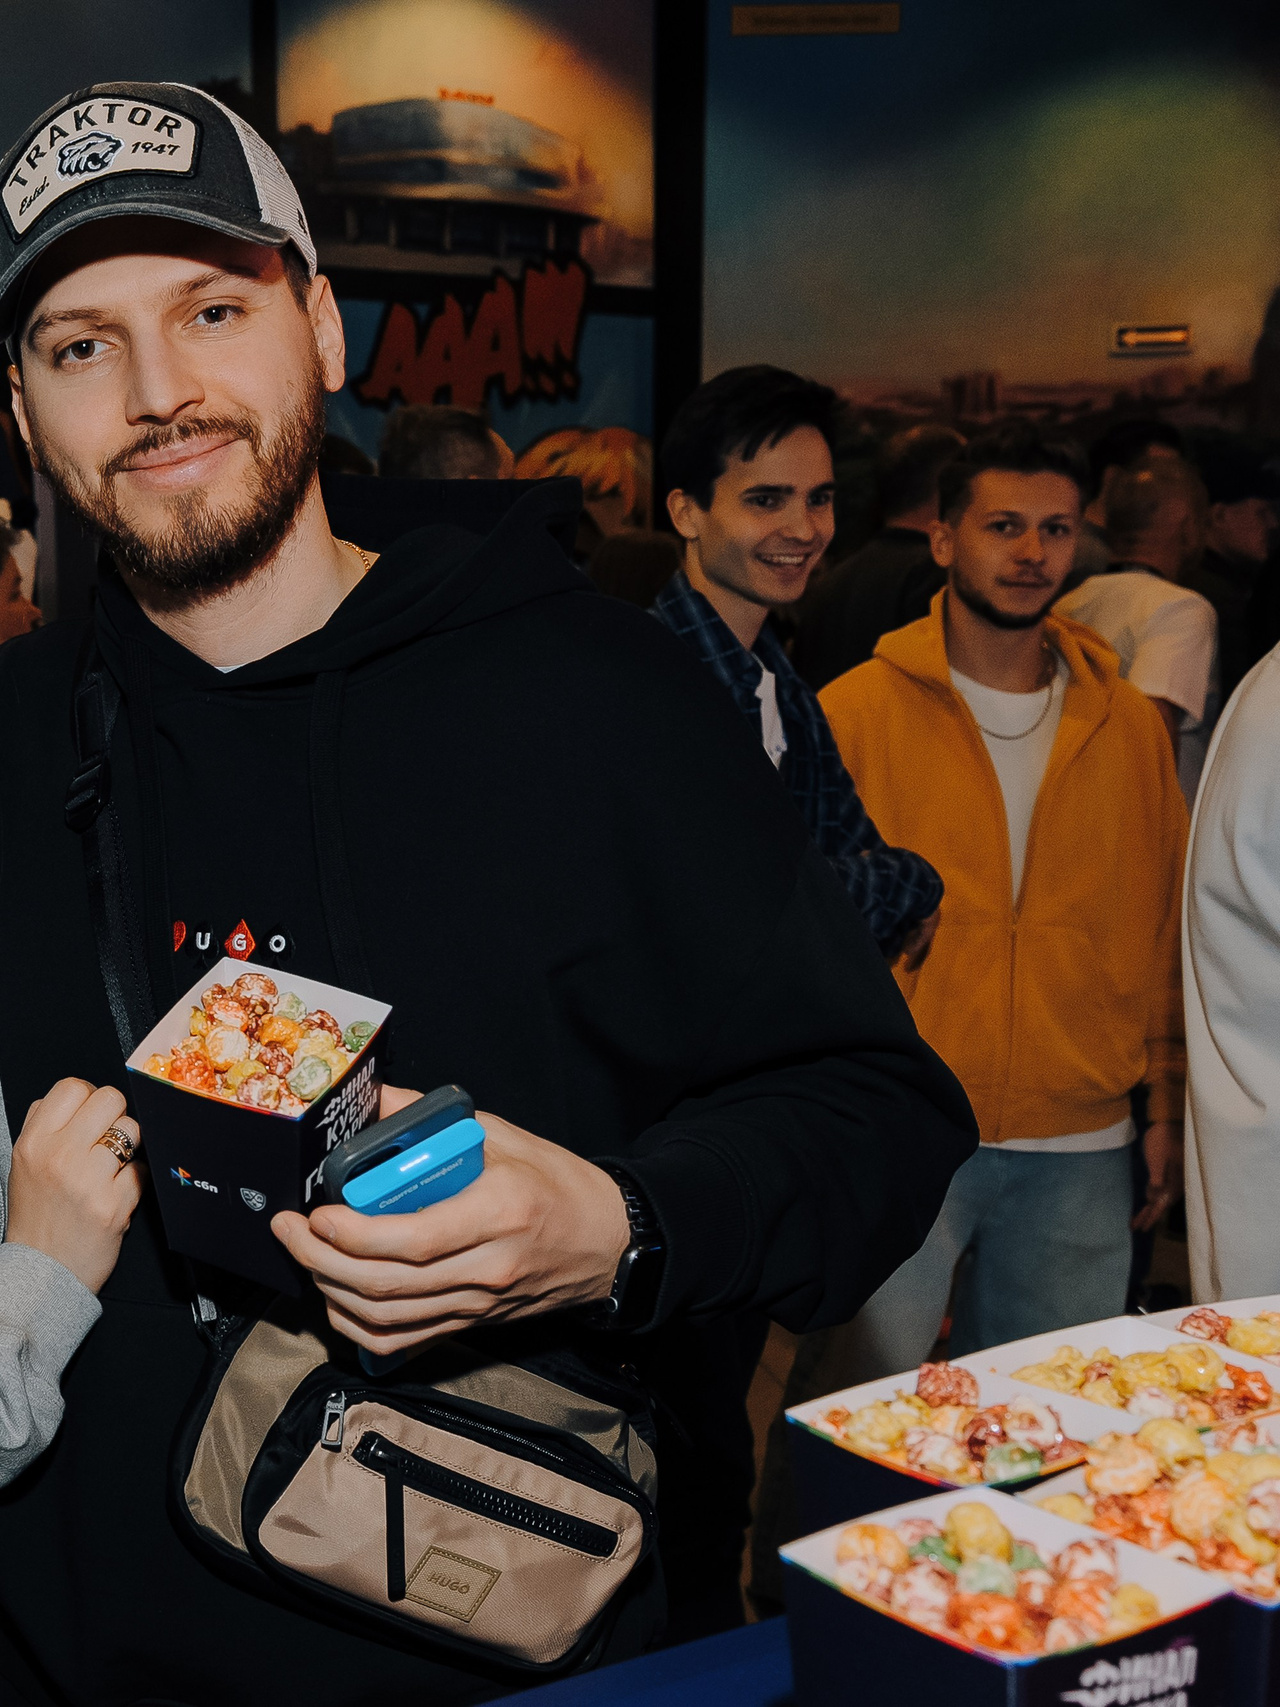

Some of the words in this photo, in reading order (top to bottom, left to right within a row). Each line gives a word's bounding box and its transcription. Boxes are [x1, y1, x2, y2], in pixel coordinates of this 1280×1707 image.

[9, 103, 182, 188] TRAKTOR
[131, 141, 179, 156] 1947
[195, 931, 286, 953] UGO
[315, 1057, 375, 1129] ФИНАЛ
[326, 1080, 373, 1150] КУБКА
[427, 1570, 470, 1595] HUGO
